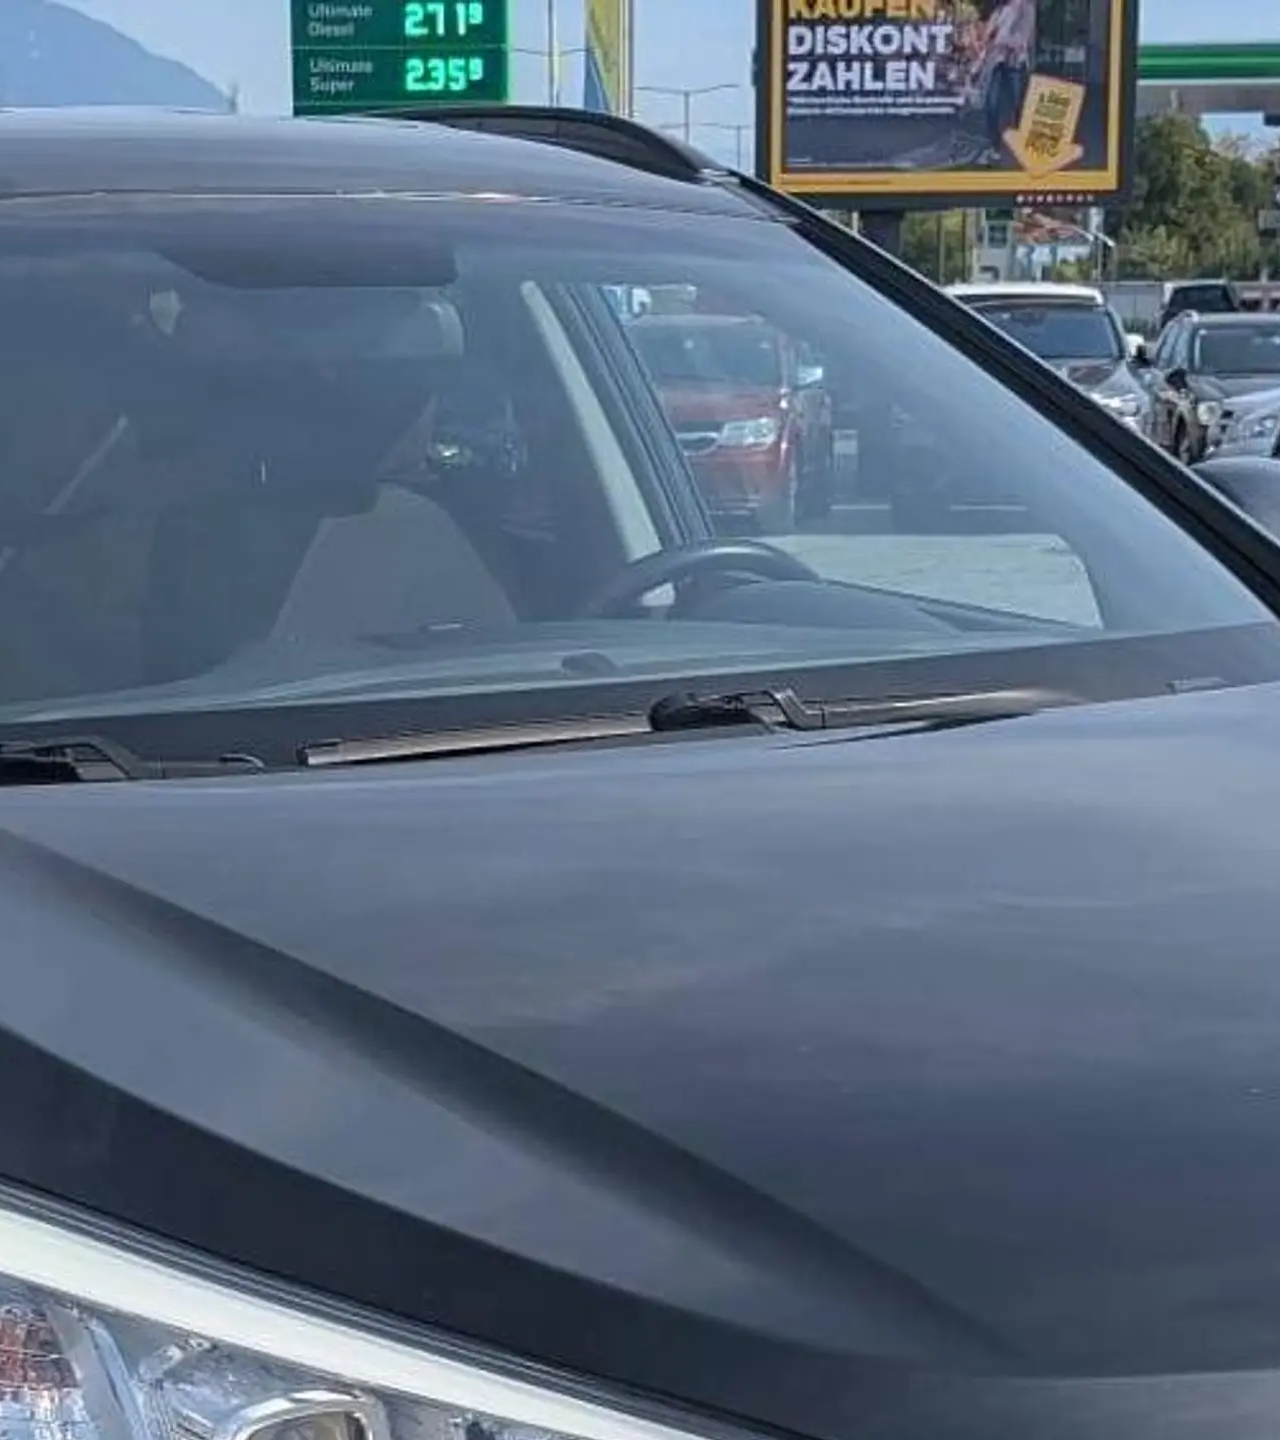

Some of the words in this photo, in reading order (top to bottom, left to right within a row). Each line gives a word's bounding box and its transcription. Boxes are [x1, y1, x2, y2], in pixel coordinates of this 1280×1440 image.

[308, 2, 372, 17] Ultimate
[308, 21, 355, 37] Diesel
[788, 24, 953, 54] DISKONT
[309, 57, 373, 73] Ultimate
[786, 61, 936, 91] ZAHLEN
[309, 77, 355, 94] Super
